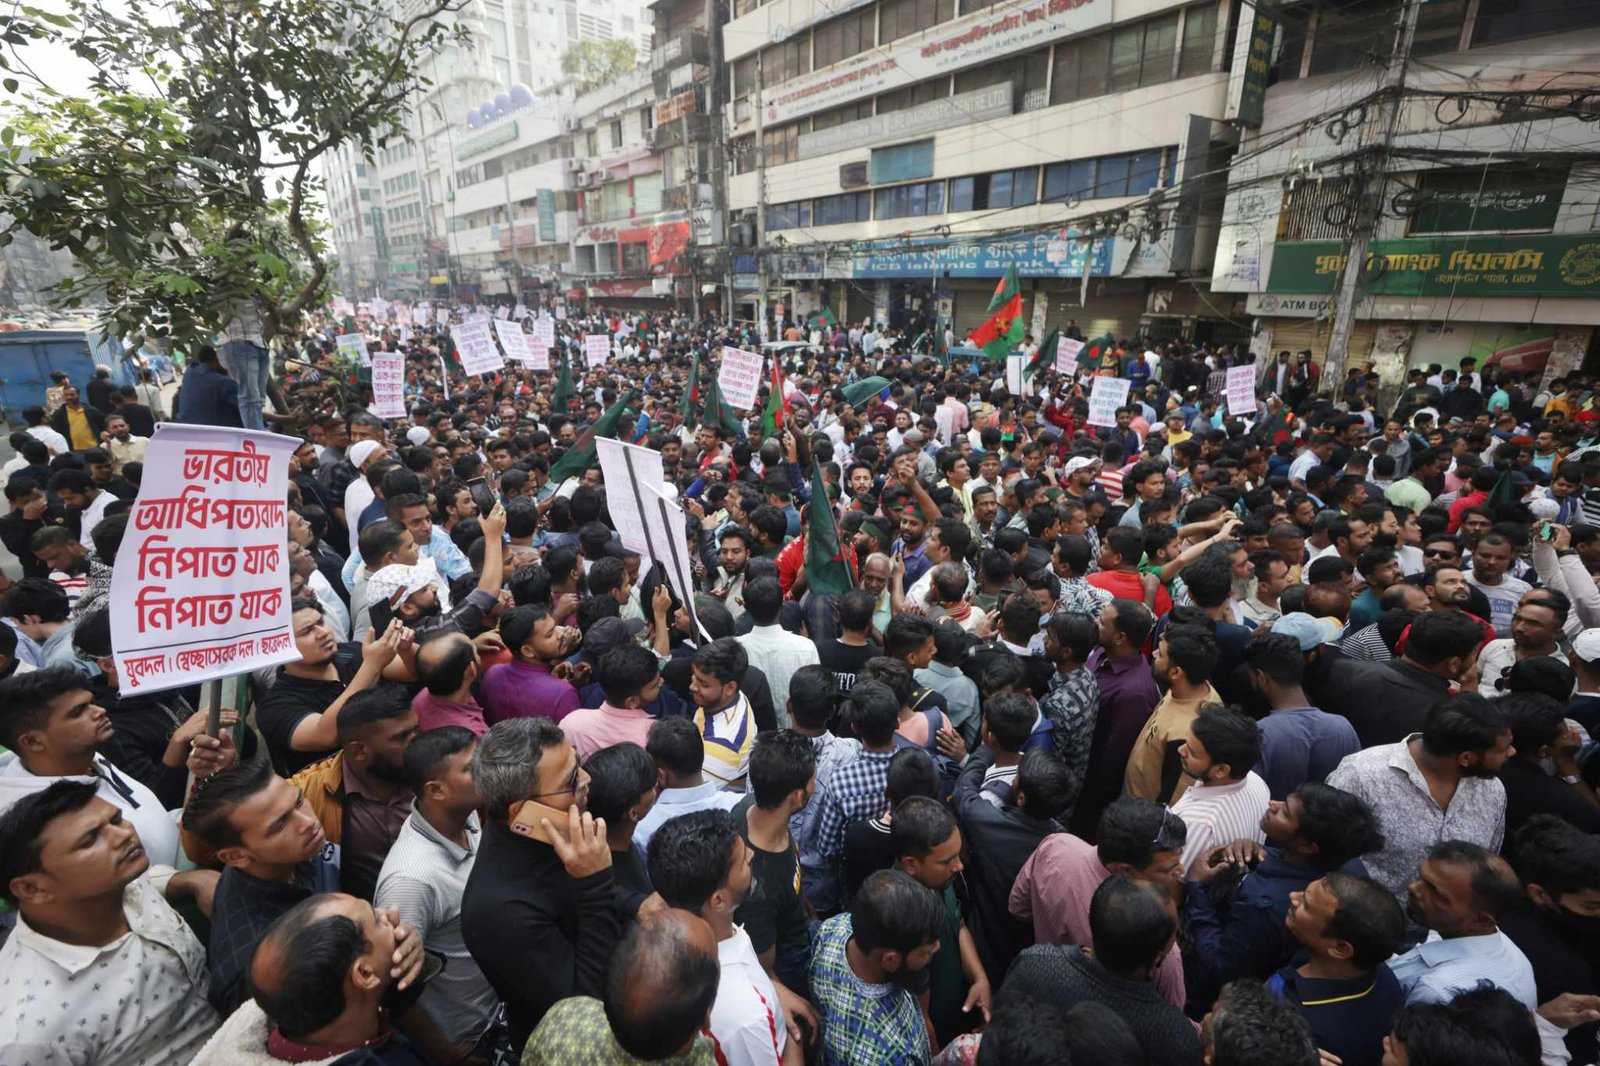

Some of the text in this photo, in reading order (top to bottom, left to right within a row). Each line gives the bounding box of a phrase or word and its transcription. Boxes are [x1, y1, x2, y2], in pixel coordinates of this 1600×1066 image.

[1280, 300, 1306, 311] ATM
[183, 440, 270, 489] ভারতীয়
[135, 486, 286, 532] আধিপত্যবাদ
[138, 535, 280, 581] নিপাত যাক
[135, 586, 283, 633] নিপাত যাক
[123, 654, 165, 687] যুবদল
[237, 639, 254, 658] দল
[261, 631, 292, 655] ছাত্রদল
